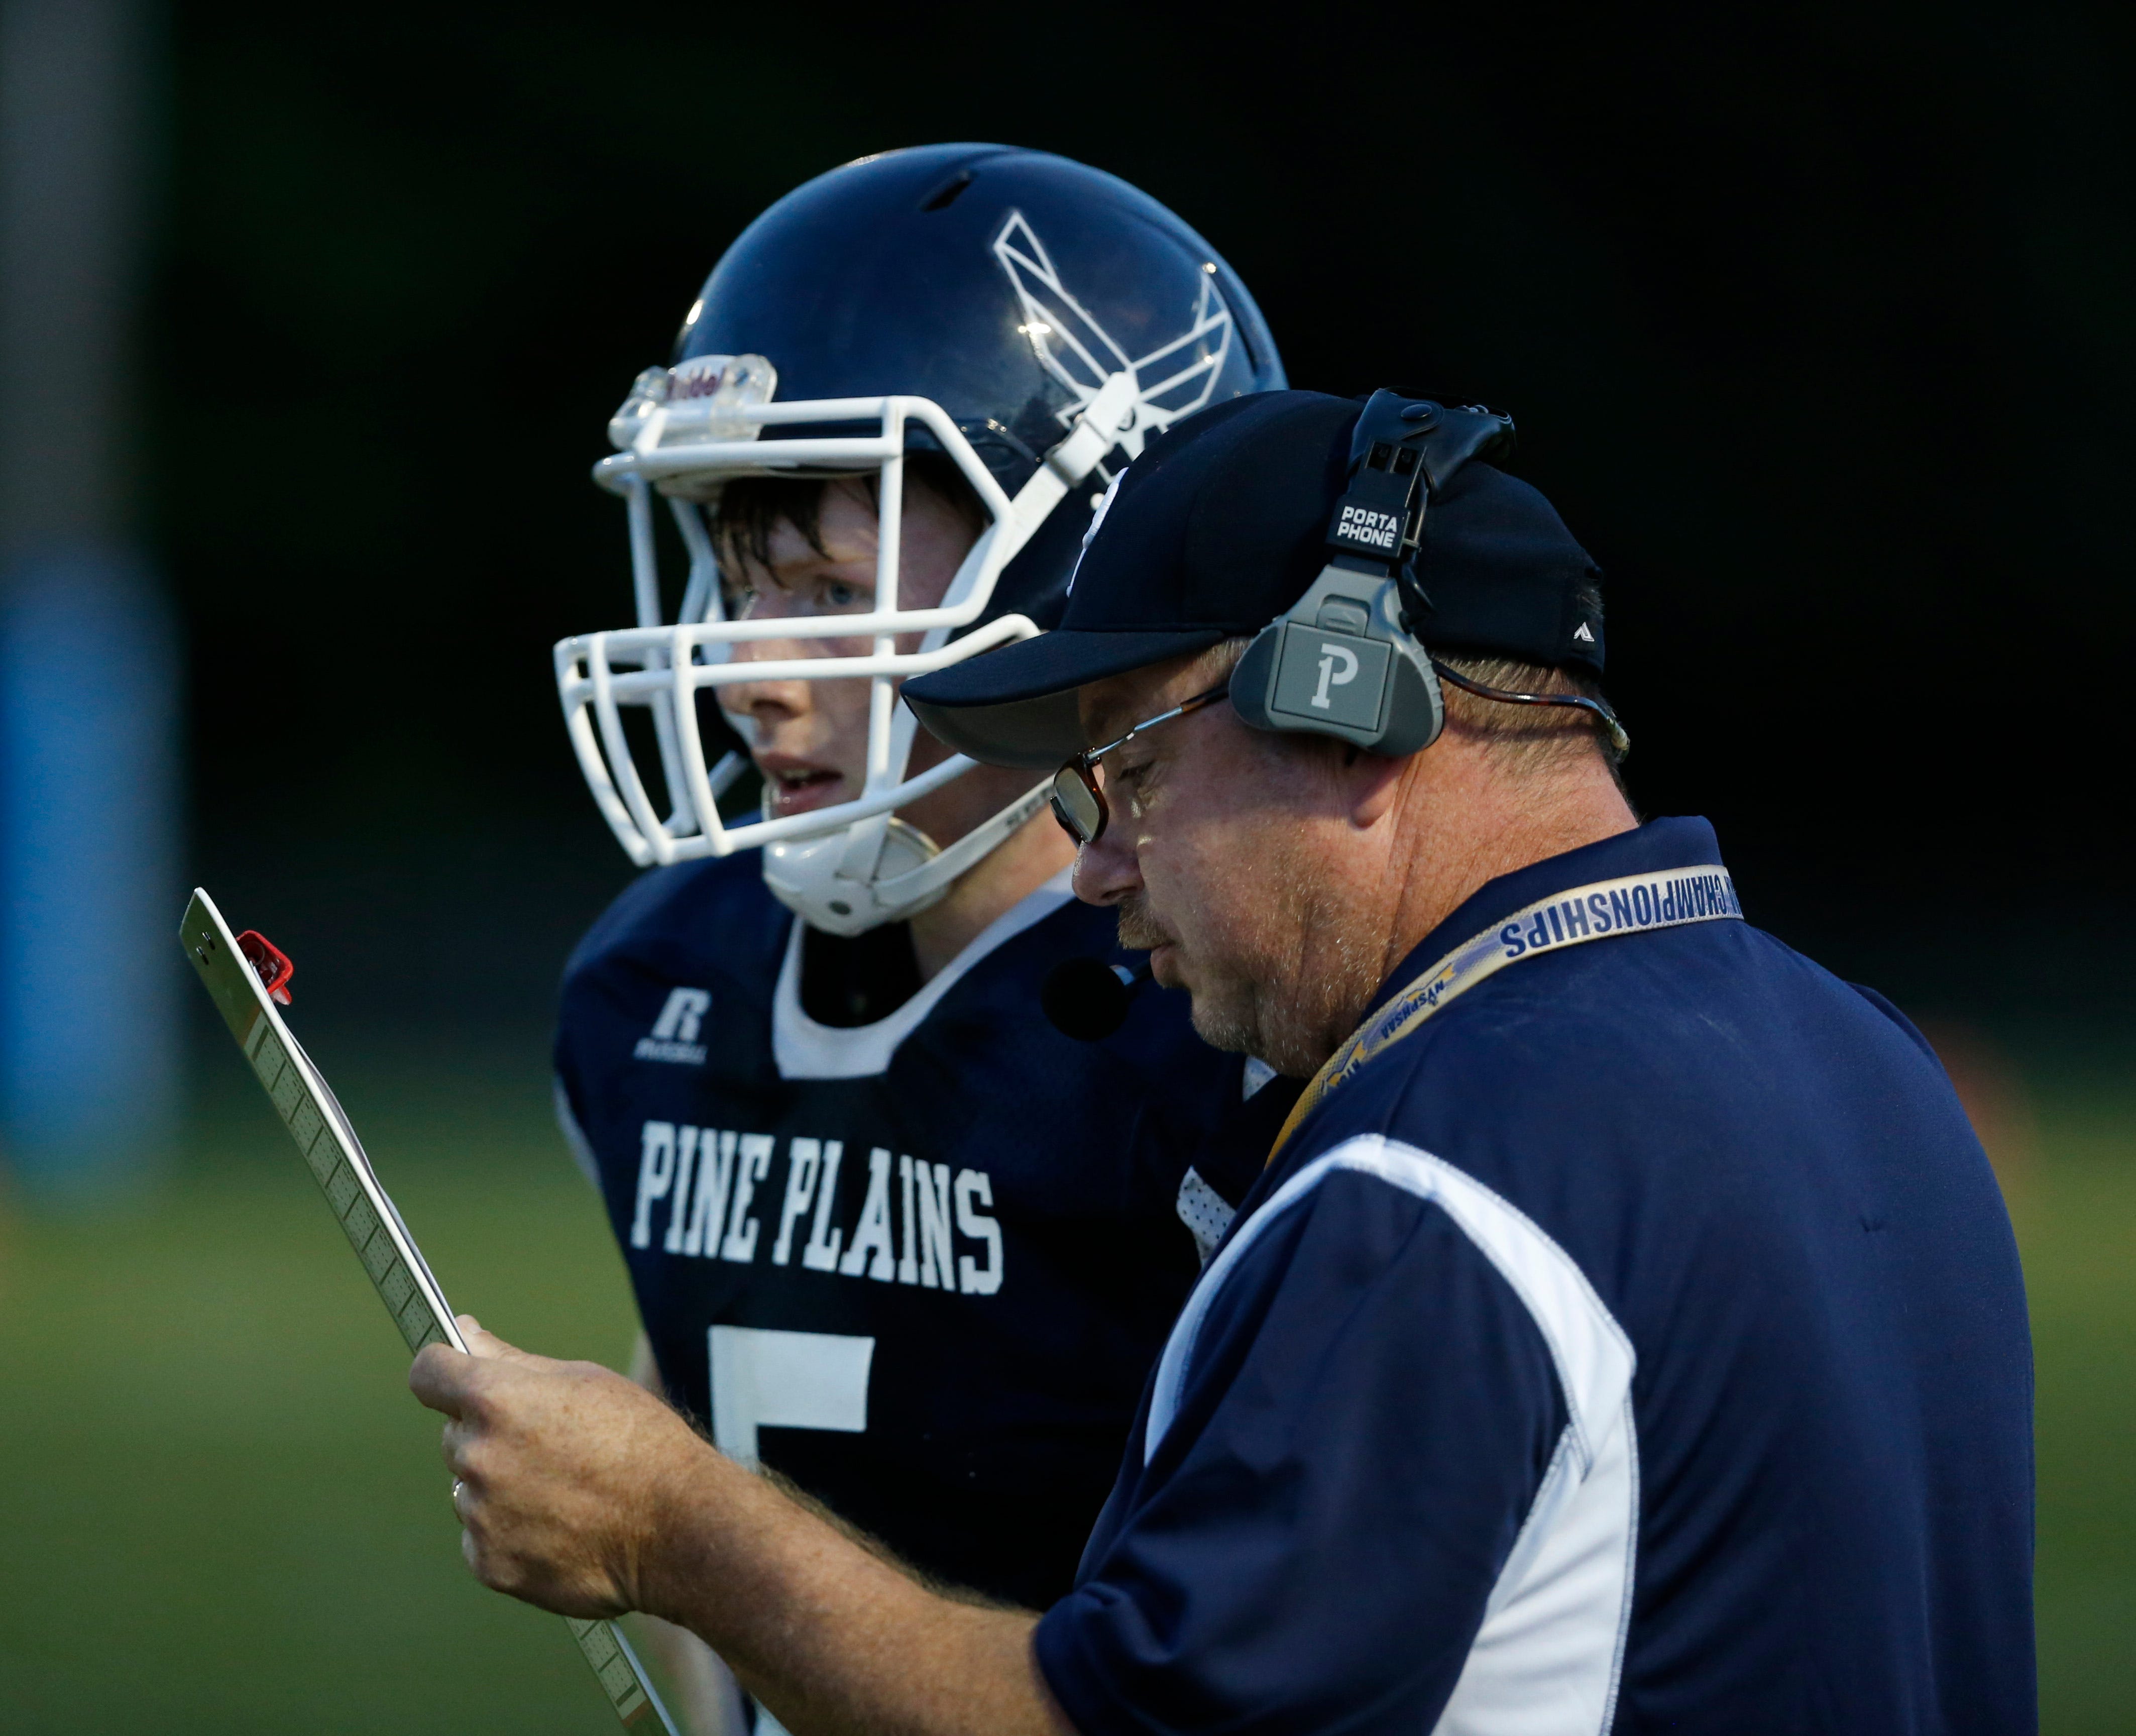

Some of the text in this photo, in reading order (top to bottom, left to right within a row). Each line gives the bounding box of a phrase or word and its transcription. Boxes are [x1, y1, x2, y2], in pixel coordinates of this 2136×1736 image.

[1336, 521, 1396, 549] PHONE
[1340, 505, 1398, 533] PORTA
[1499, 874, 1727, 958] CHAMPIONSHIPS
[650, 985, 713, 1041] R
[630, 1120, 775, 1263] PINE
[772, 1137, 1004, 1295] PLAINS
